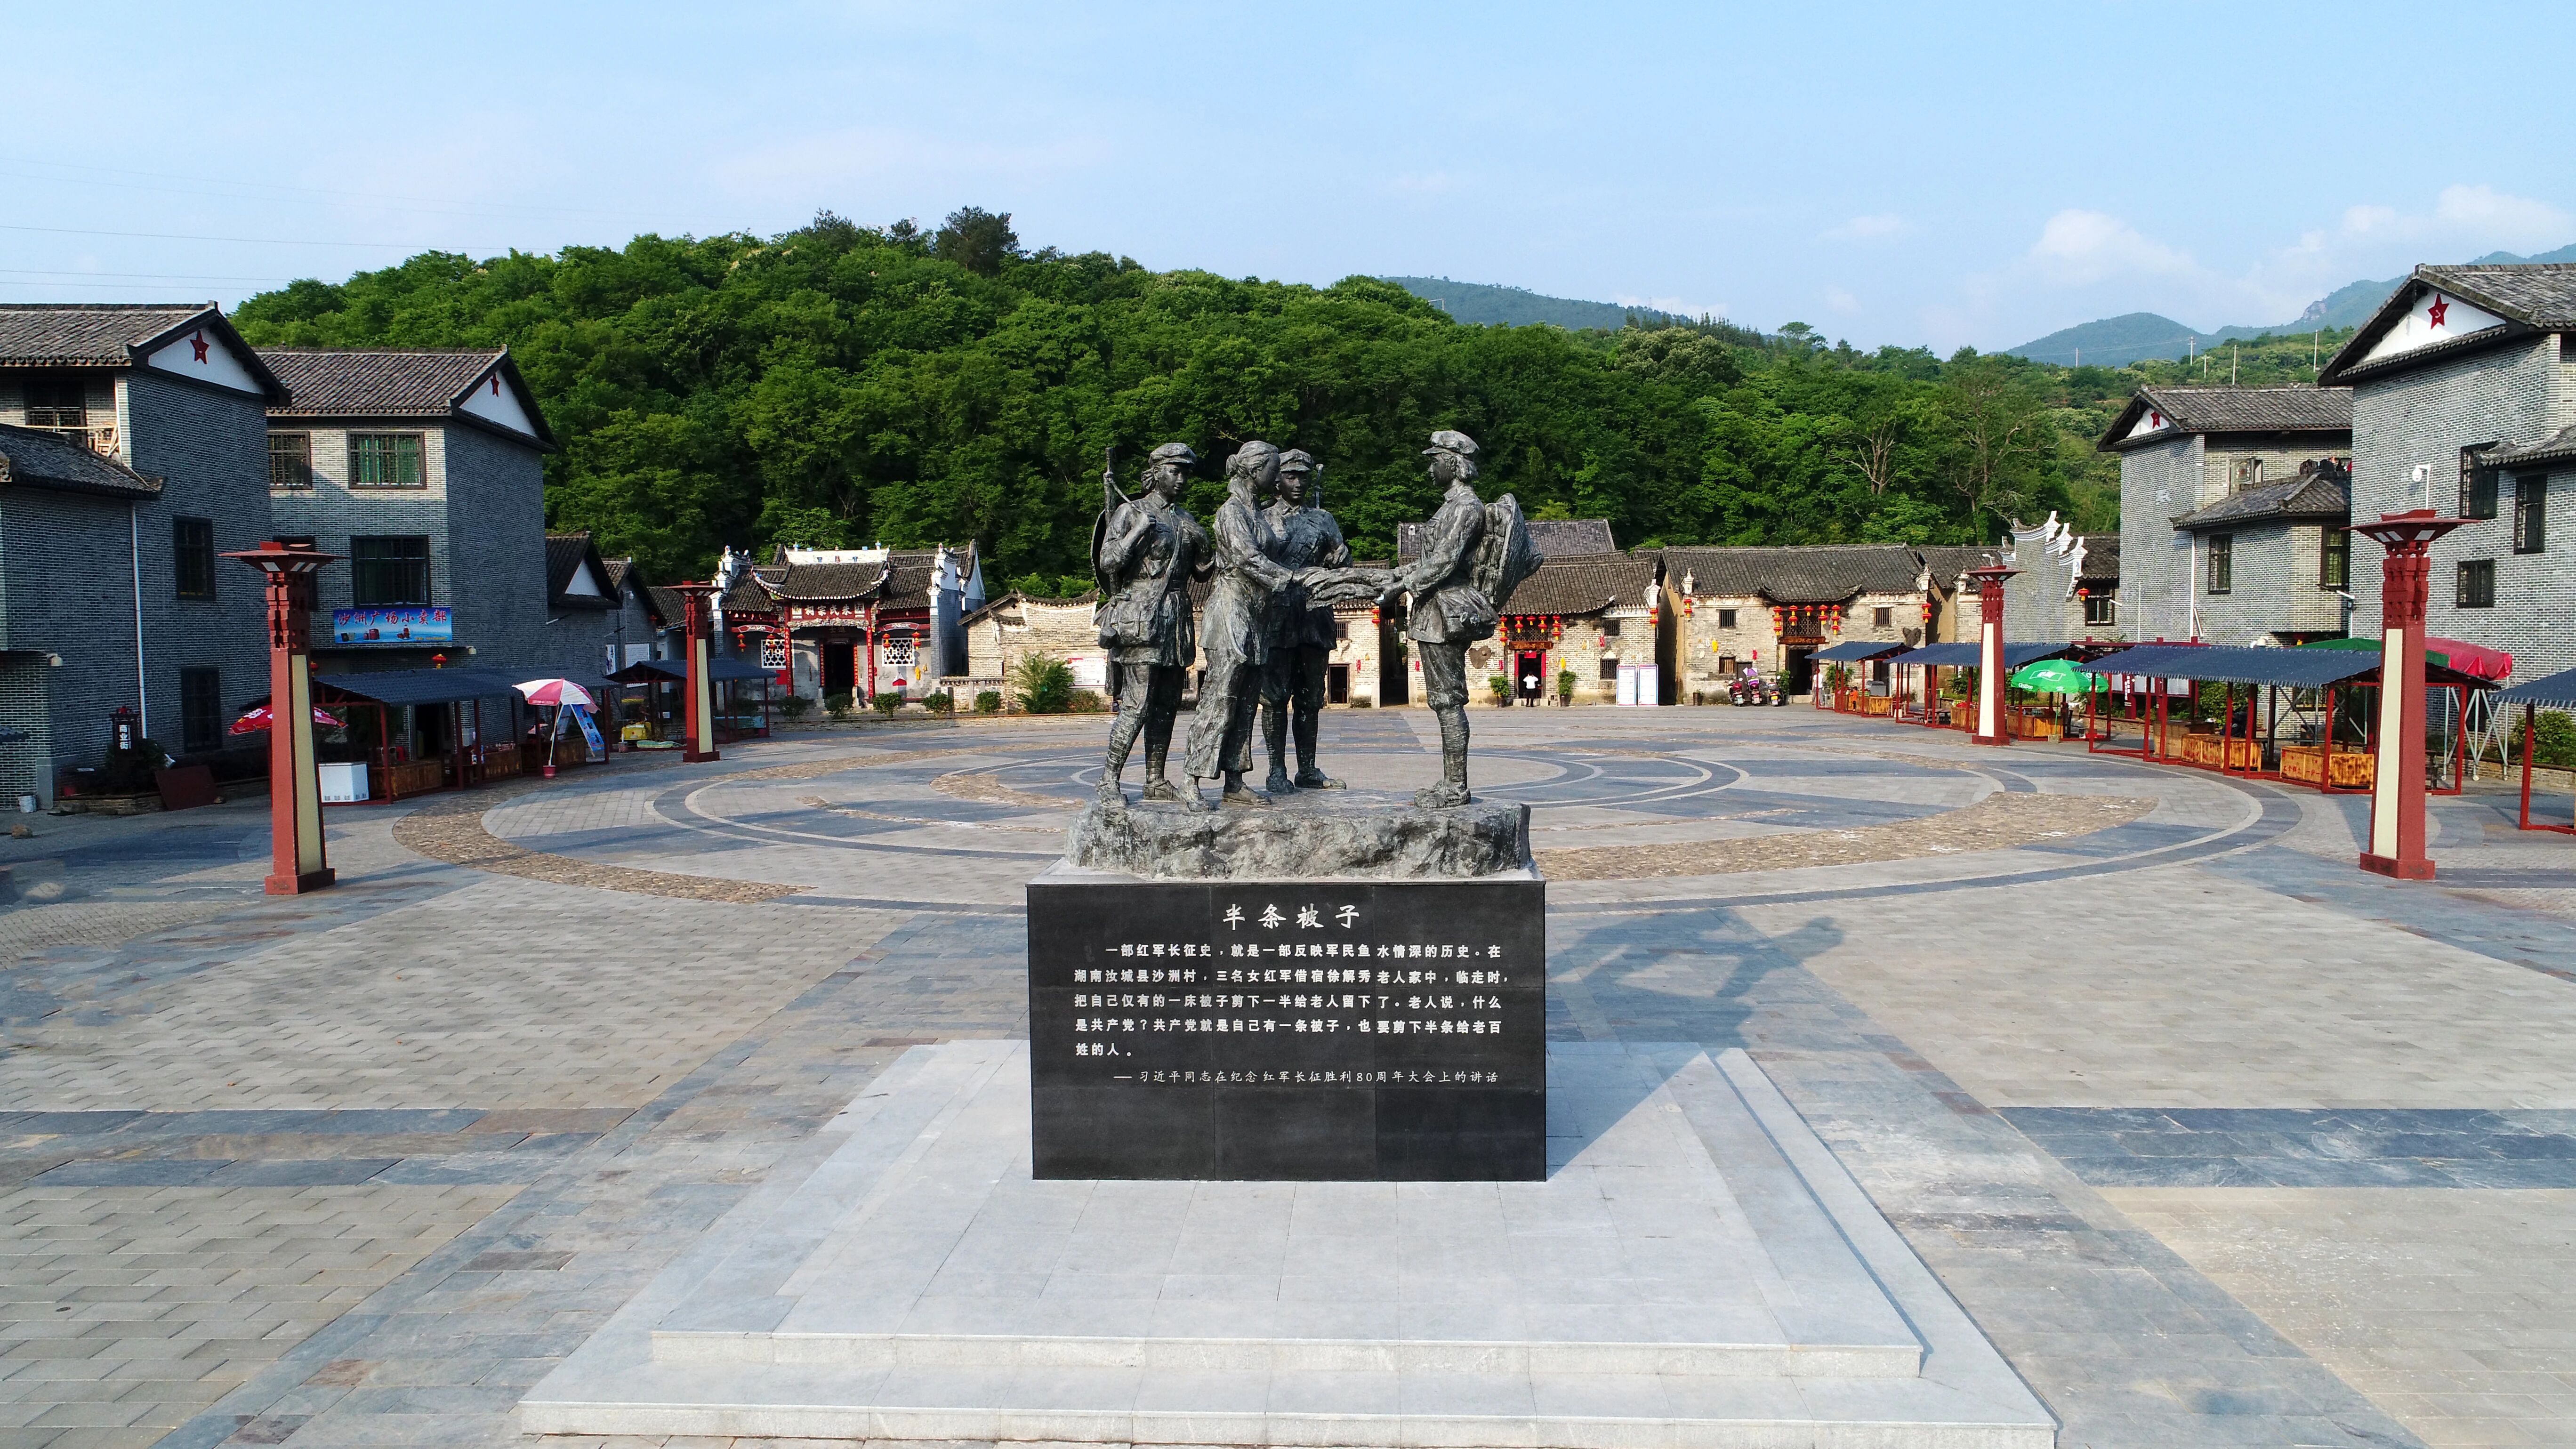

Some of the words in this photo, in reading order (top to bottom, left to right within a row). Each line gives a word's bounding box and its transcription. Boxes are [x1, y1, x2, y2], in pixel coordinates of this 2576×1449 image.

[338, 609, 447, 626] 沙洲广场小卖部
[1223, 903, 1360, 930] 半条被子
[1105, 943, 1501, 958] 一部红军长征史，就是一部反映军民鱼水情深的历史。在
[1074, 994, 1502, 1009] 把自己仅有的一床被子剪下一半给老人留下了。老人说，什么
[1075, 1018, 1502, 1034] 是共产党？共产党就是自己有一条被子，也要剪下半条给老百
[1075, 1042, 1132, 1057] 姓的人。
